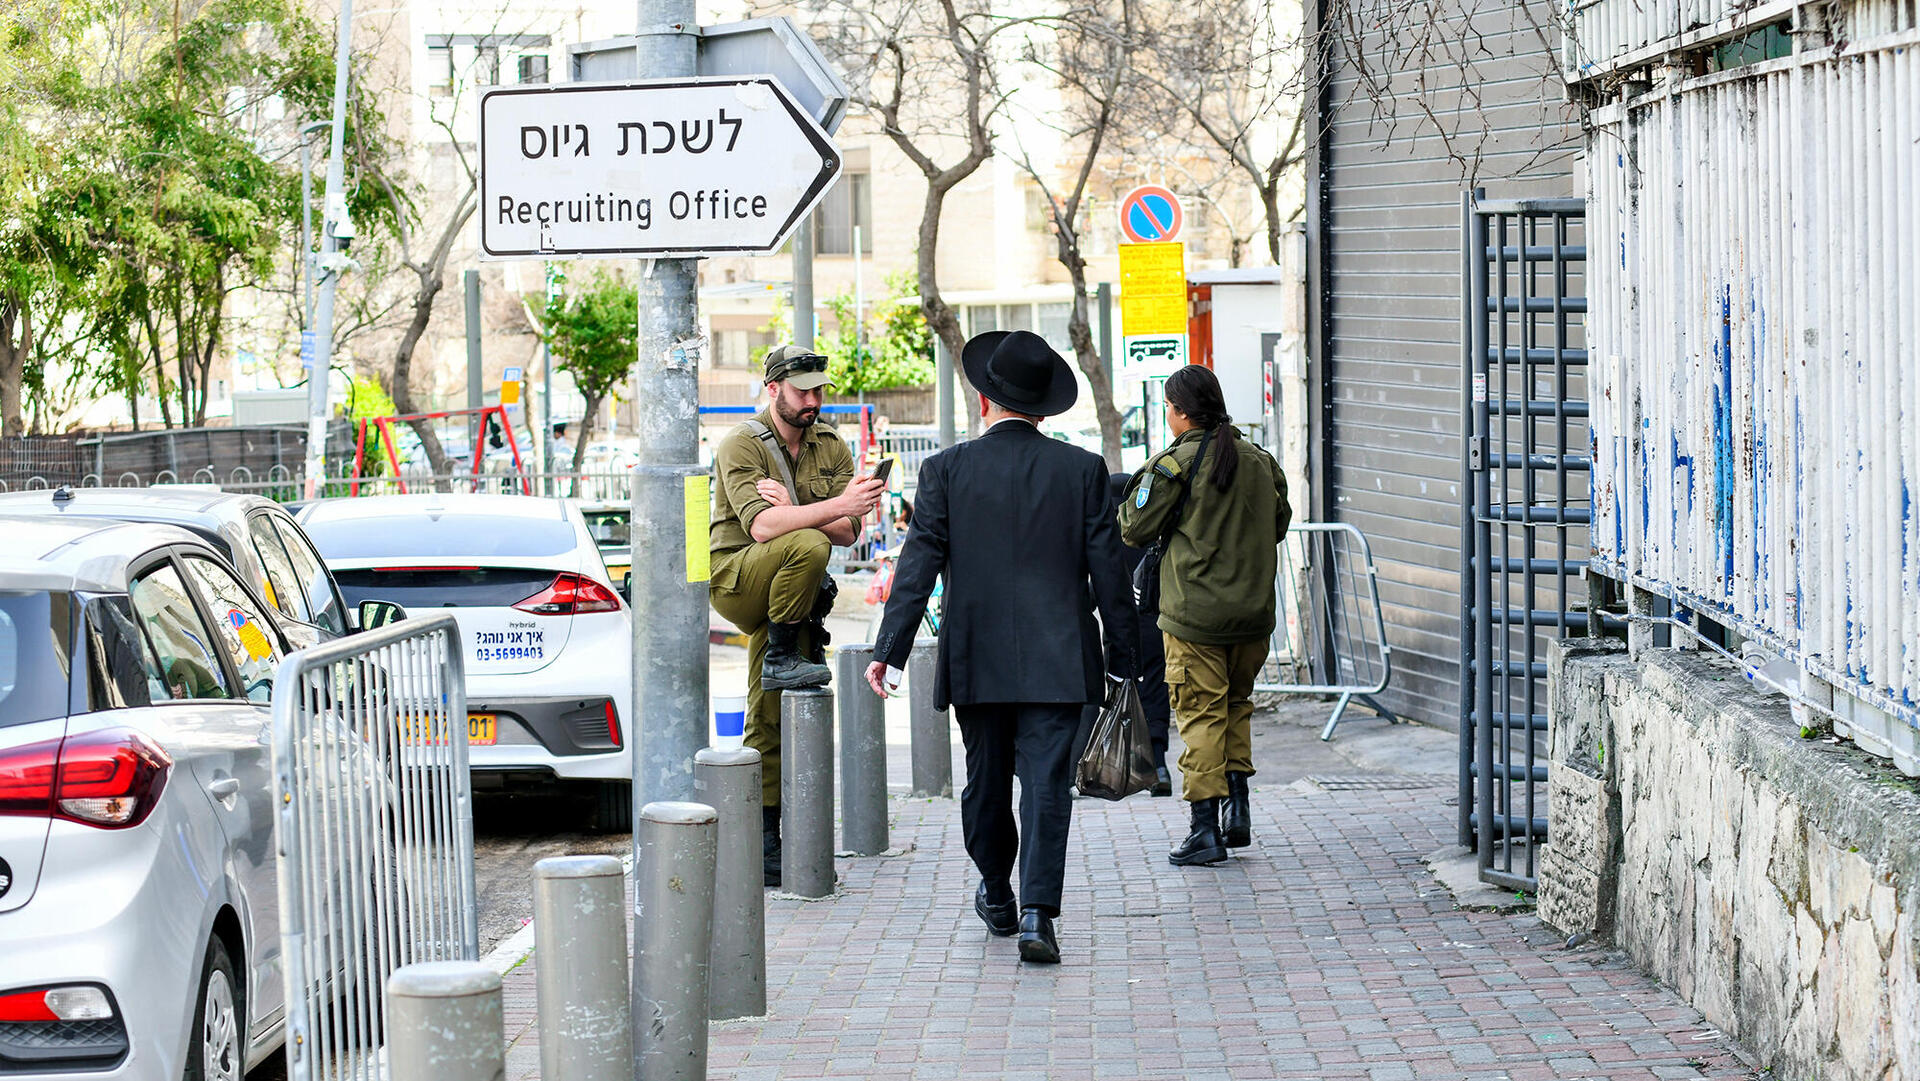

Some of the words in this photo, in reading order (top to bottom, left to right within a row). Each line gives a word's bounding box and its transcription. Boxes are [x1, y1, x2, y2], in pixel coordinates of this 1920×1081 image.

[617, 108, 743, 156] לשכת
[520, 124, 590, 159] גיוס
[498, 192, 651, 230] Recruiting
[669, 189, 768, 220] Office
[509, 621, 536, 630] hybrid
[476, 632, 504, 644] נוהג?
[507, 632, 523, 643] אני
[525, 631, 544, 646] איך
[476, 646, 544, 661] 03-5699403
